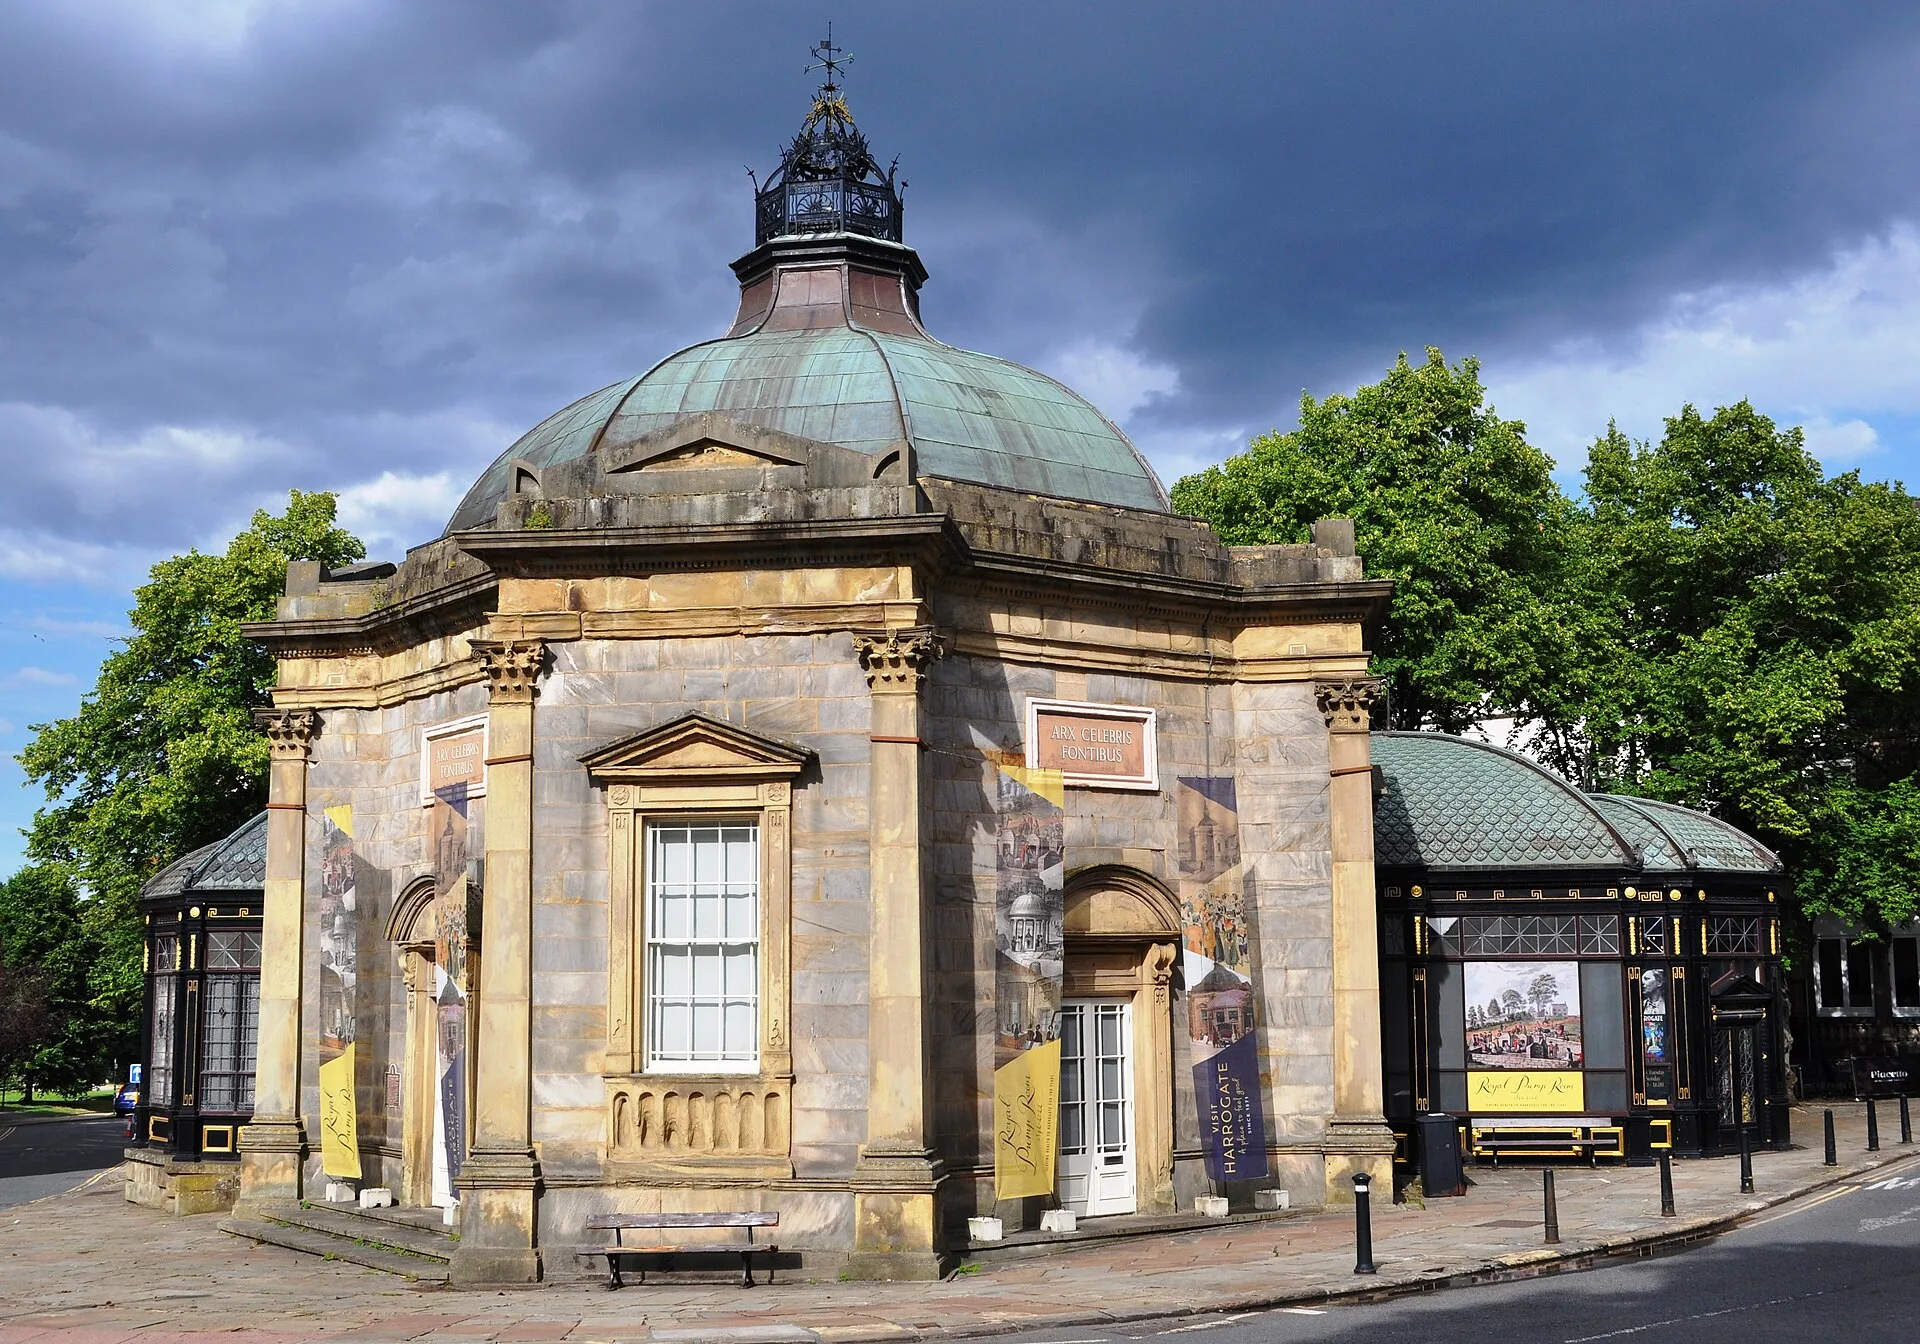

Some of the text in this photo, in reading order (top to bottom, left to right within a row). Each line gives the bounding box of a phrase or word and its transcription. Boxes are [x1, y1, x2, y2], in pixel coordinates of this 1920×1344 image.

[435, 741, 480, 763] ARX CELEBRIS
[1051, 725, 1133, 745] ARX CELEBRIS
[1061, 745, 1123, 763] FONTIBUS
[440, 760, 474, 779] FONTIBUS
[1475, 1076, 1512, 1096] Royal
[1510, 1074, 1547, 1094] Pump
[322, 1086, 343, 1135] Royal
[997, 1094, 1021, 1151] Royal
[1015, 1073, 1037, 1176] Pump Room
[1210, 1103, 1219, 1133] VISIT
[1217, 1062, 1236, 1174] HARROGATE
[1231, 1077, 1249, 1155] A place to feel good
[337, 1110, 355, 1160] Pump
